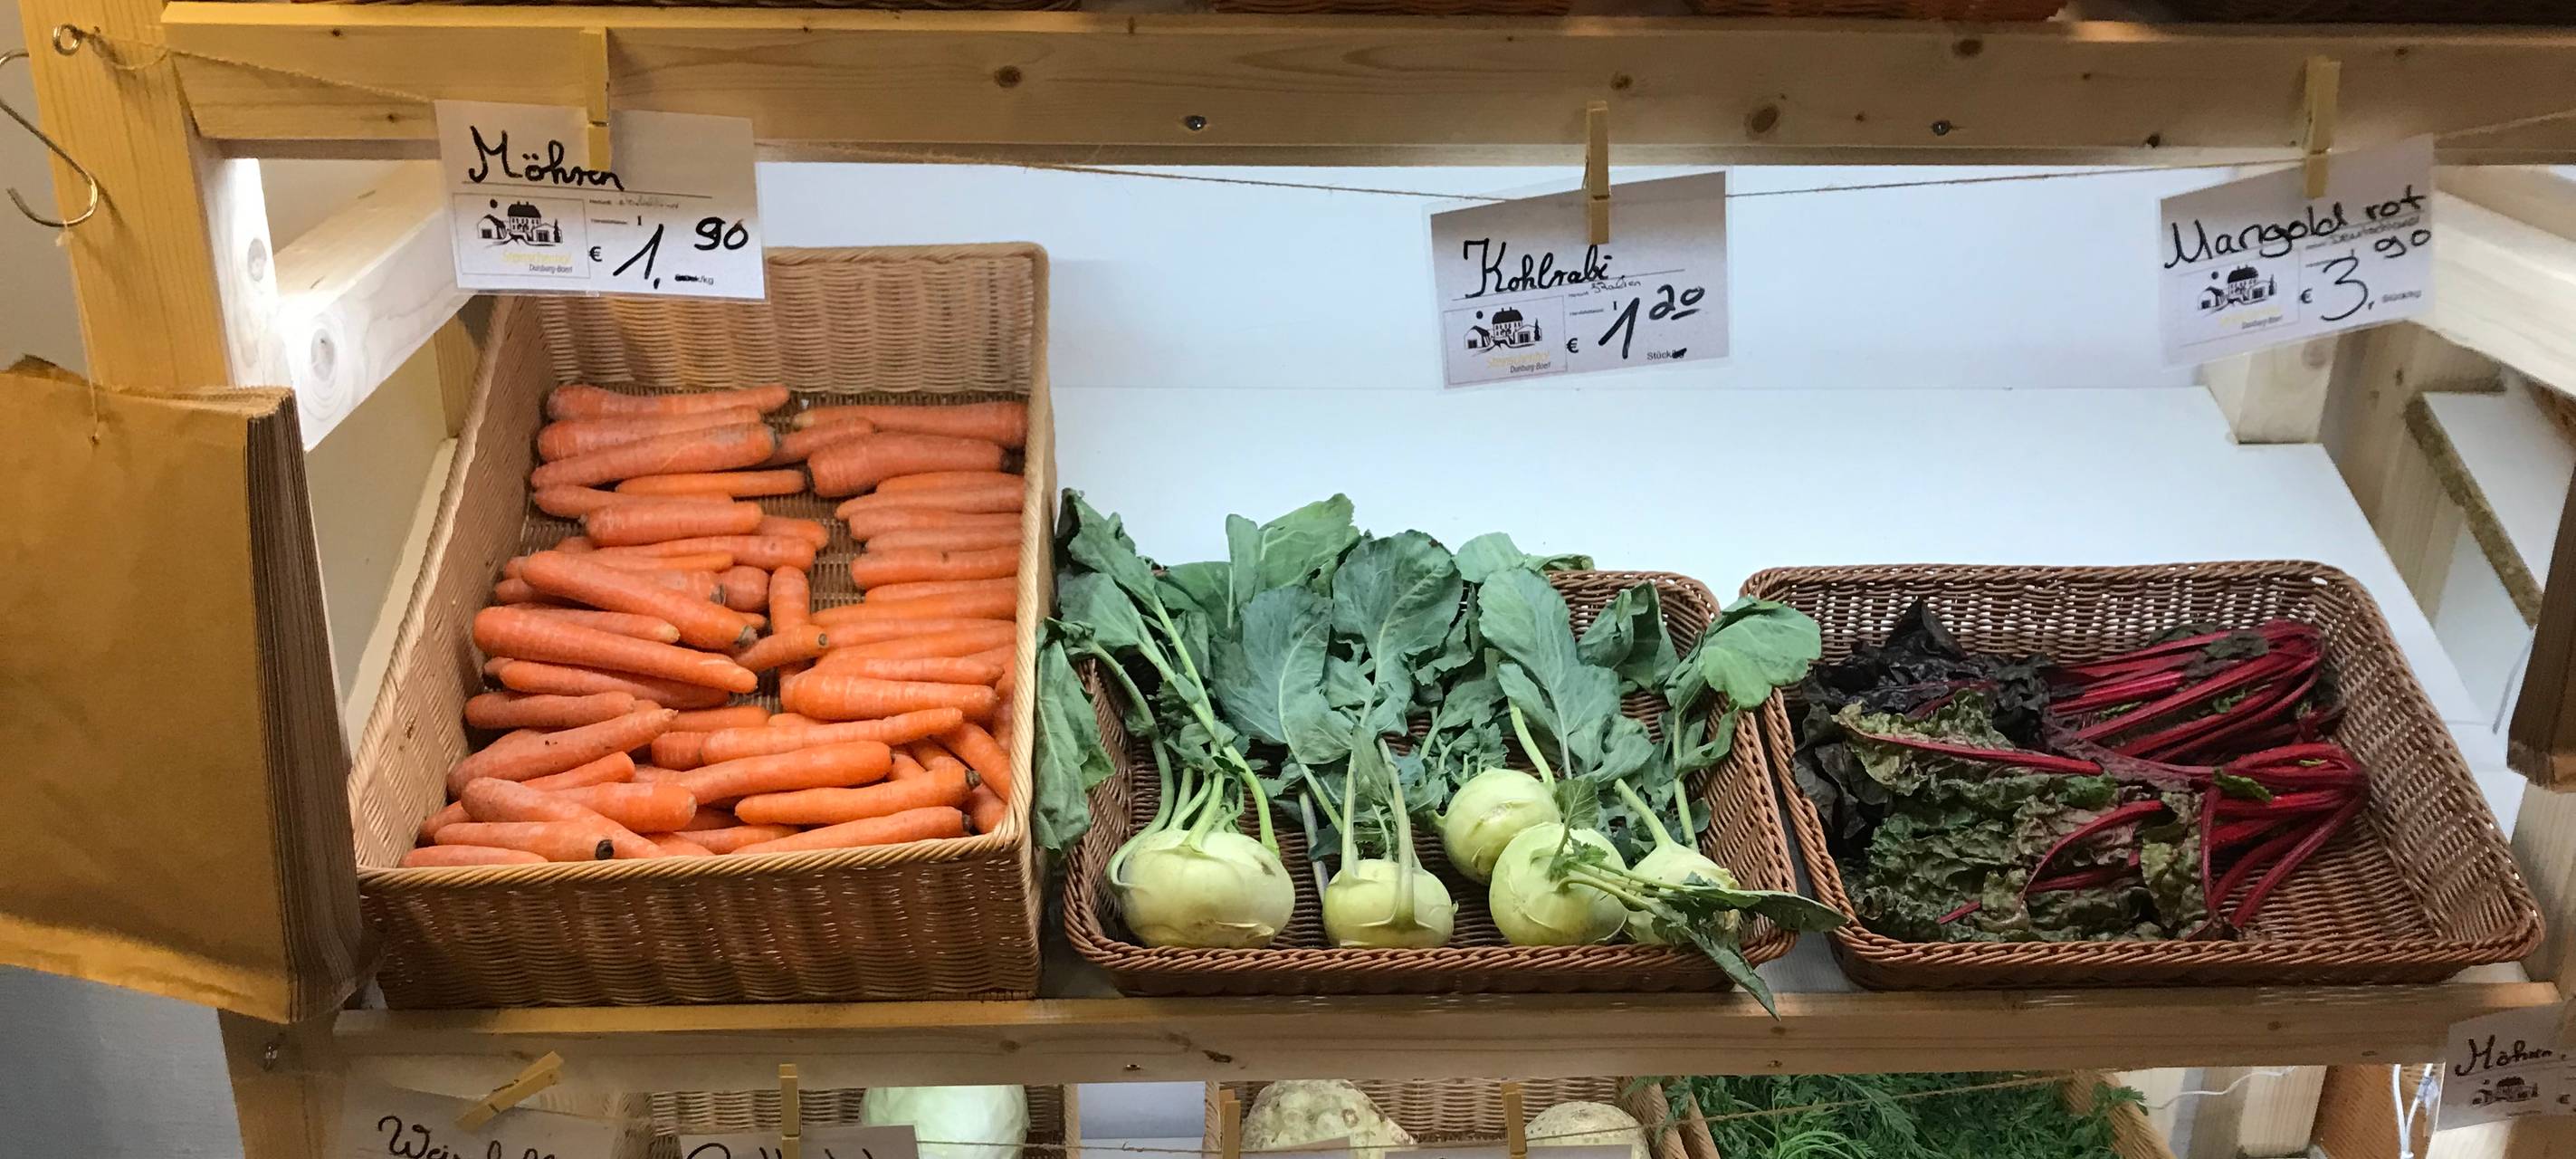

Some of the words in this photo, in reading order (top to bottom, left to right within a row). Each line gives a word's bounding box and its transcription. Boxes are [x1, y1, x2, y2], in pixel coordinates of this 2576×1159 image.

[468, 125, 625, 192] Möhren
[2164, 202, 2348, 269] Mangold
[2364, 185, 2426, 222] rot
[589, 245, 603, 263] €
[2301, 289, 2313, 304] €
[1566, 337, 1579, 354] €
